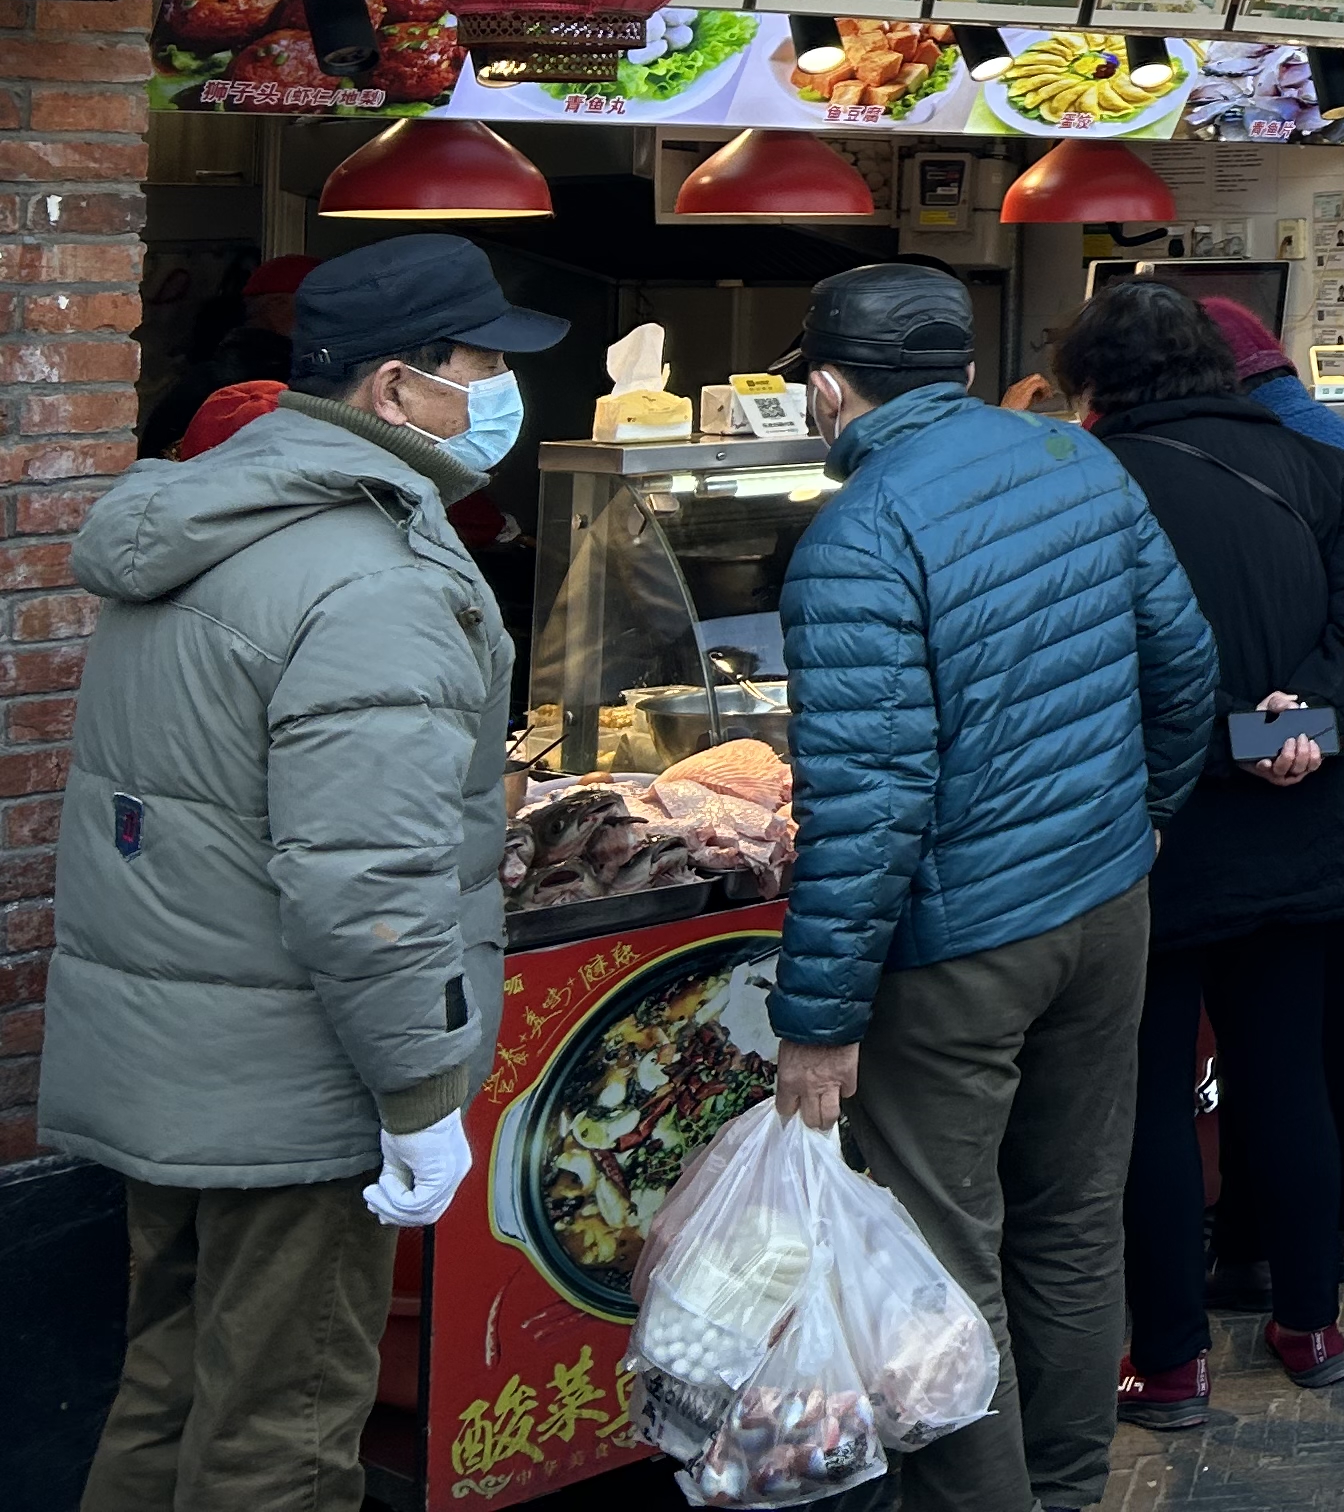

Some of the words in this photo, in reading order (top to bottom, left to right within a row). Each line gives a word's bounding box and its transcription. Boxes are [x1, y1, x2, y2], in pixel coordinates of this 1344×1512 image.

[202, 80, 281, 105] 狮子头
[563, 93, 627, 115] 青鱼丸
[824, 105, 883, 124] 鱼豆腐
[1058, 113, 1092, 131] 蛋饺
[1249, 120, 1297, 139] 青鱼片
